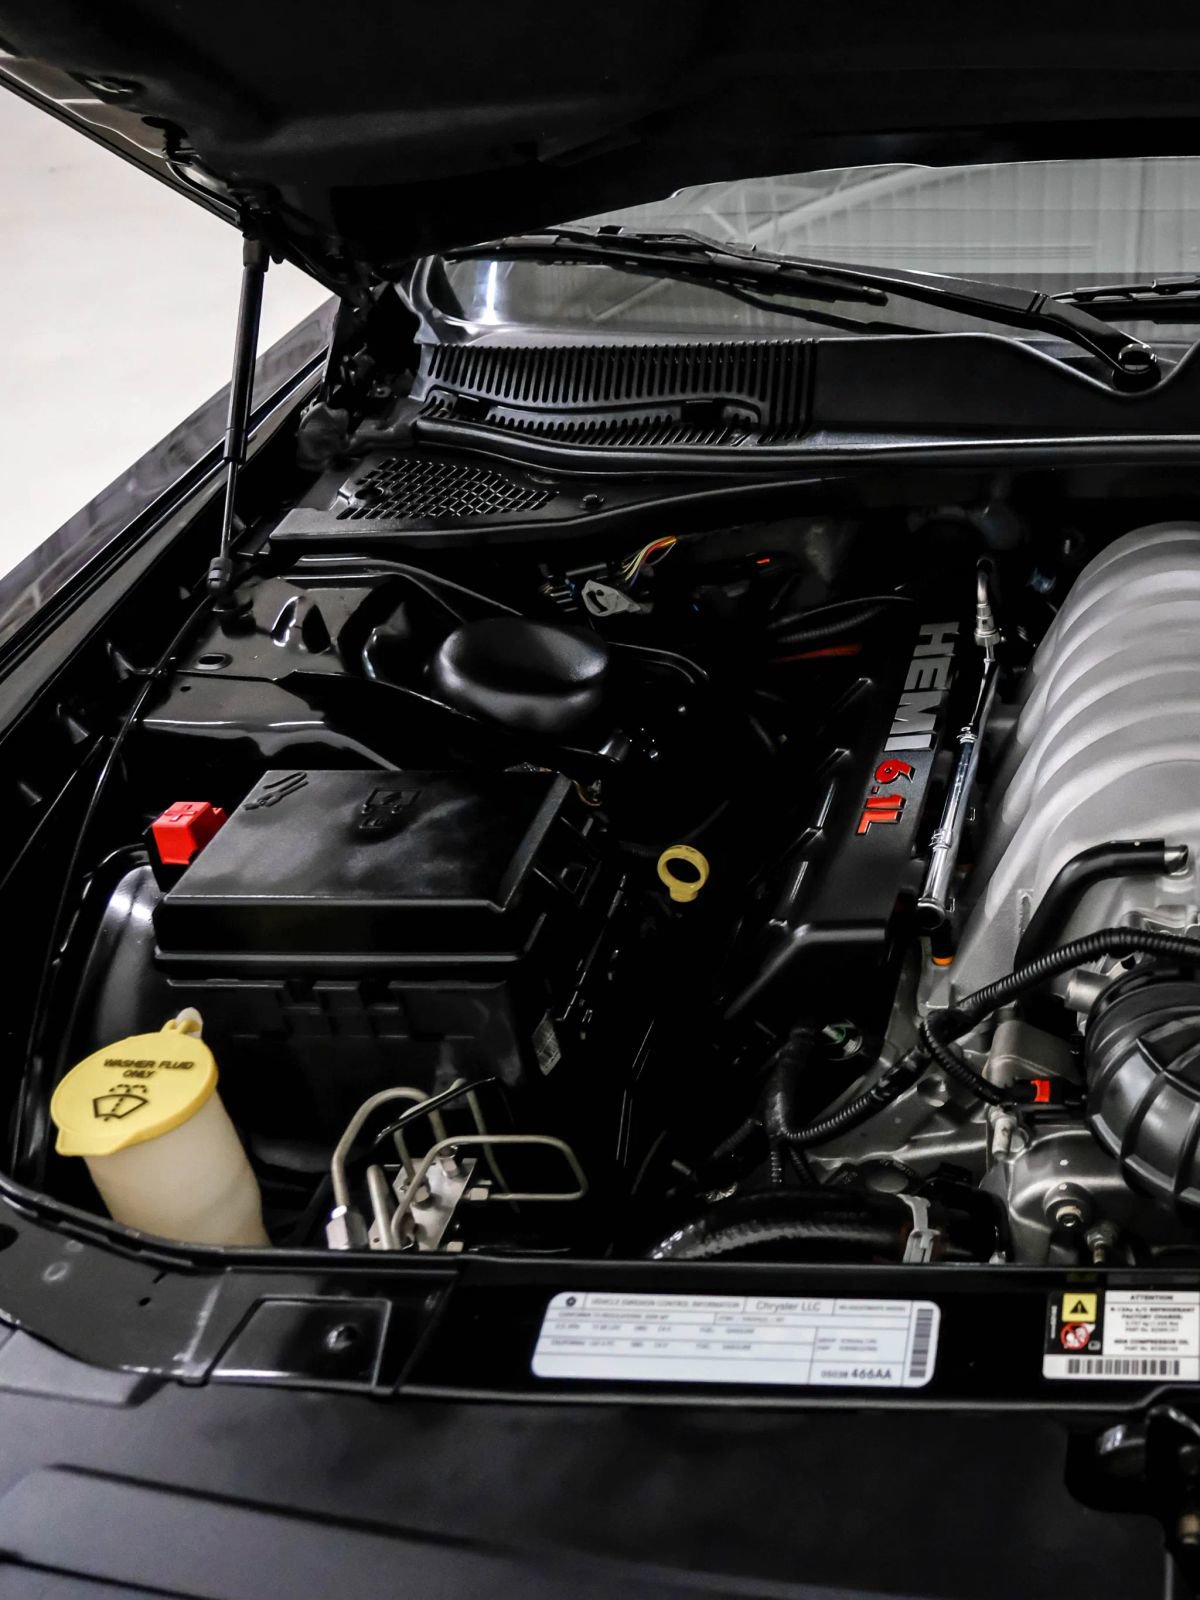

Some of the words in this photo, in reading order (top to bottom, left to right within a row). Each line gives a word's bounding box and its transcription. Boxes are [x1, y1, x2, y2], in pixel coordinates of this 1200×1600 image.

[884, 621, 960, 752] HEMI
[856, 759, 915, 835] 6.1L
[104, 1059, 156, 1069] WASHER
[159, 1061, 195, 1070] FLUID
[123, 1070, 156, 1079] ONLY
[756, 1300, 798, 1313] Chrysler
[801, 1302, 821, 1312] LLC
[851, 1368, 892, 1380] 466AA
